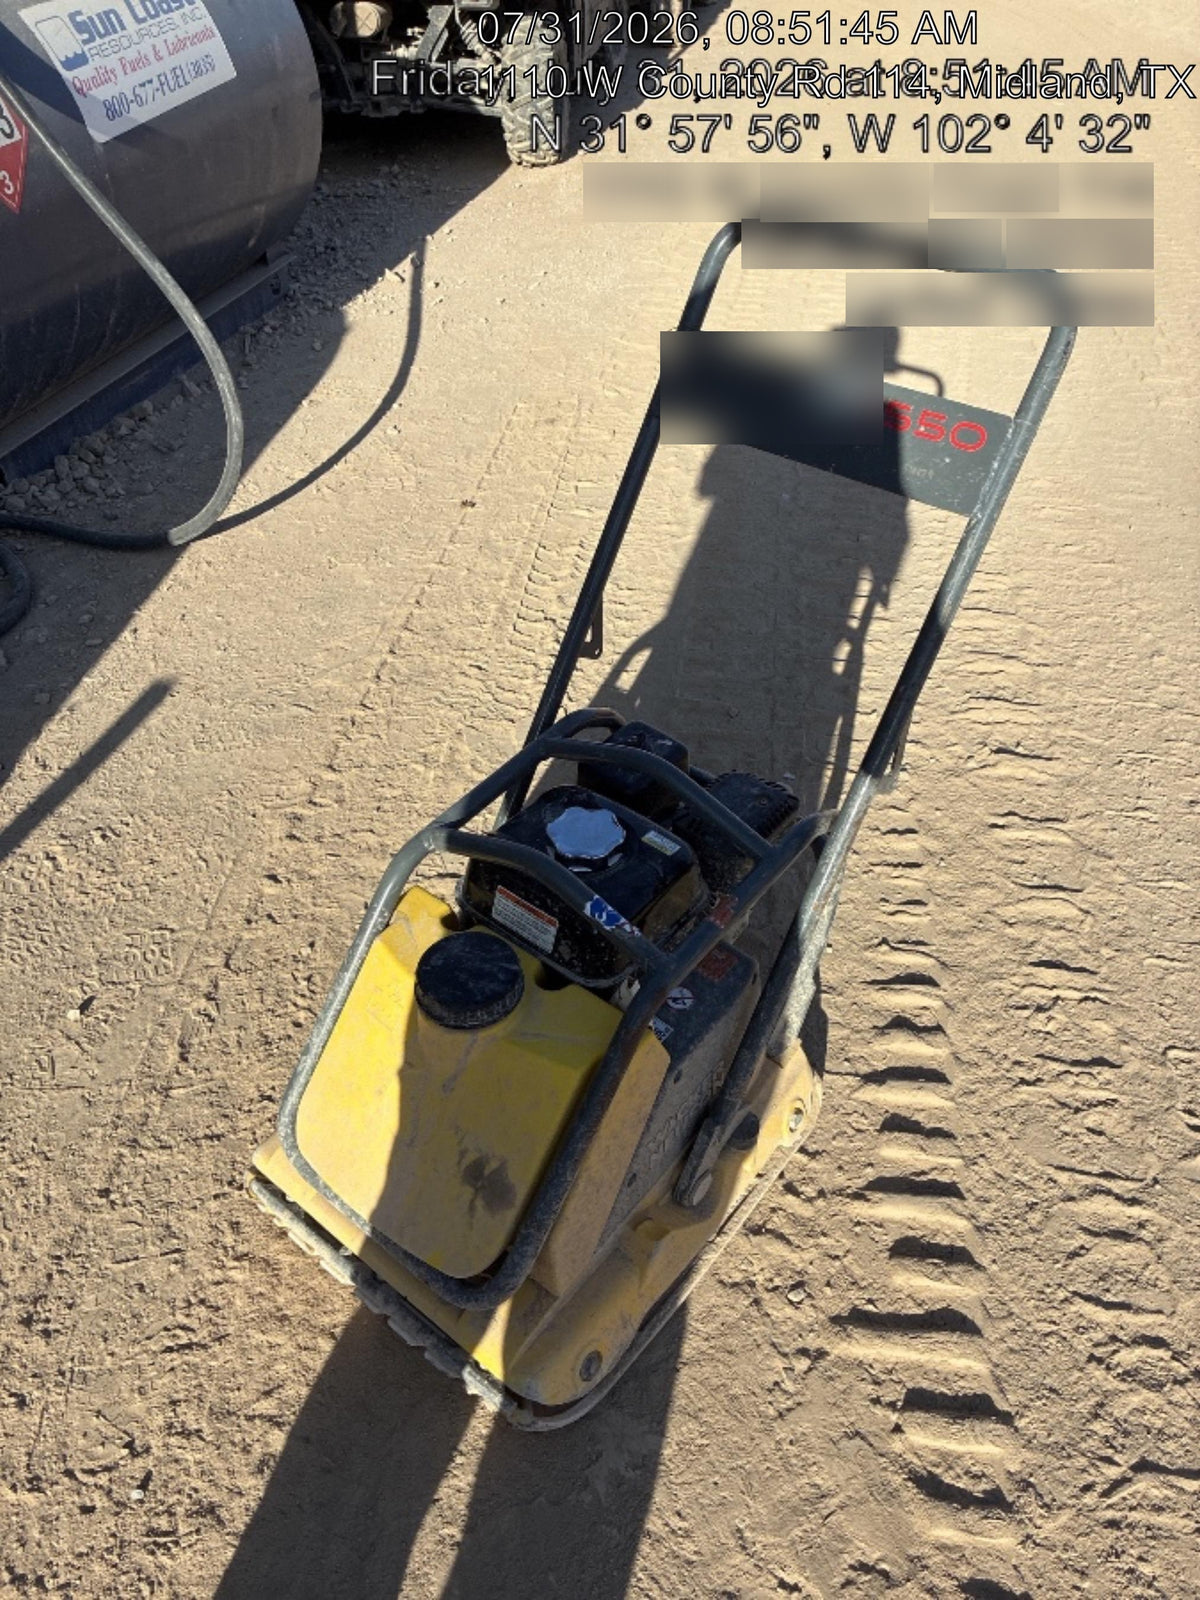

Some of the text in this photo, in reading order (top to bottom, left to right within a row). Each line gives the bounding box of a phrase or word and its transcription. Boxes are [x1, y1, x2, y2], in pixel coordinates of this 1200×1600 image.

[67, 0, 196, 46] Sun Coa
[72, 62, 118, 98] Quality
[119, 49, 151, 76] Fuels
[151, 43, 164, 63] &
[0, 169, 14, 195] 3
